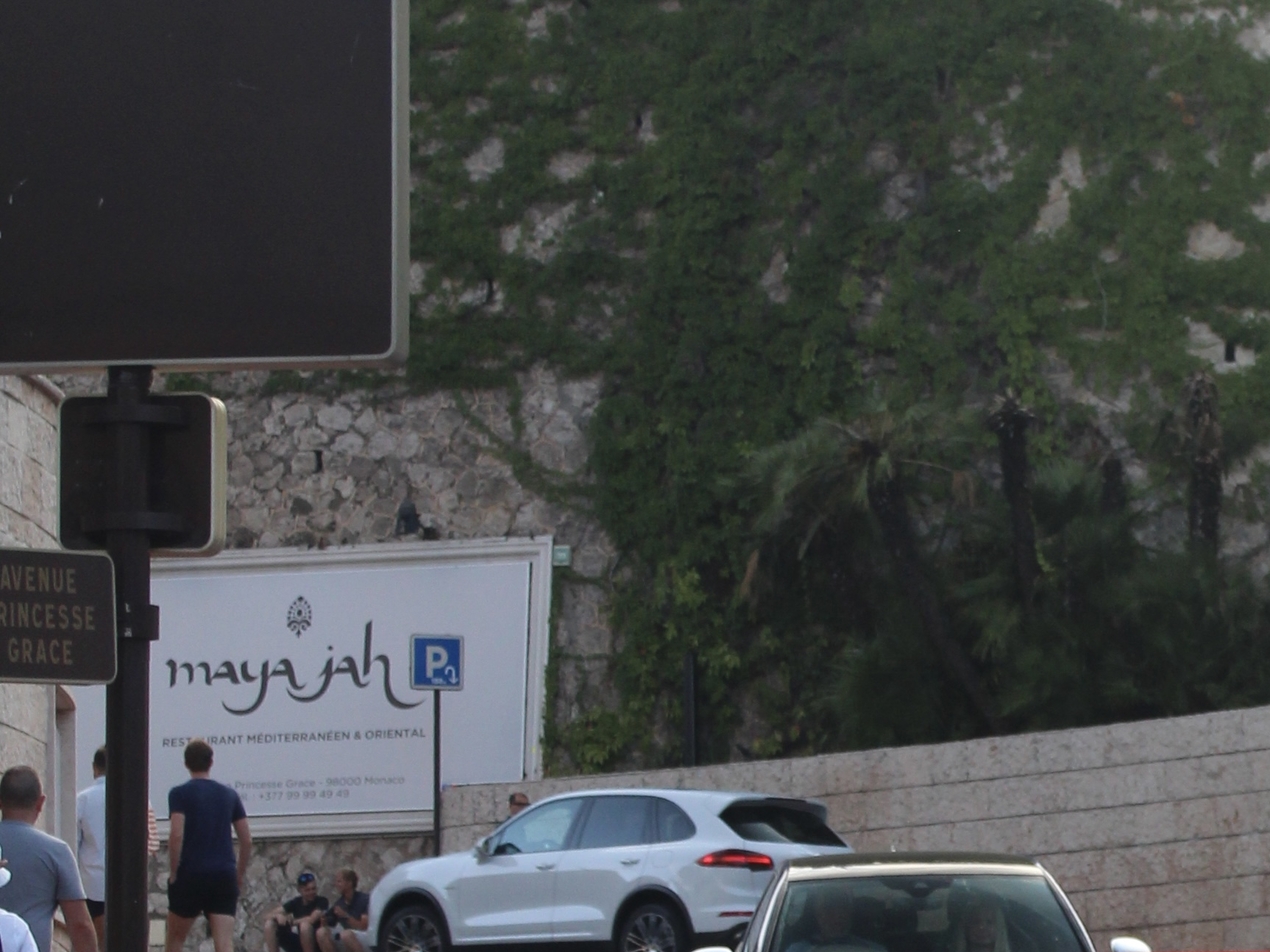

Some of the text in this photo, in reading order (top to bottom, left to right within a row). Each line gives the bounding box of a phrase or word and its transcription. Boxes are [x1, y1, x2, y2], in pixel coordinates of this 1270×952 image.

[1, 565, 77, 594] AVENUE
[0, 601, 95, 630] RINCESSE
[8, 637, 73, 665] GRACE
[426, 645, 448, 679] P
[247, 730, 350, 743] MÉDITERRANÉEN
[354, 731, 361, 740] &
[365, 728, 426, 740] ORIENTAL
[235, 781, 283, 789] Princesse
[285, 779, 316, 788] Grace
[326, 777, 361, 787] 98000
[364, 776, 404, 785] Monaco
